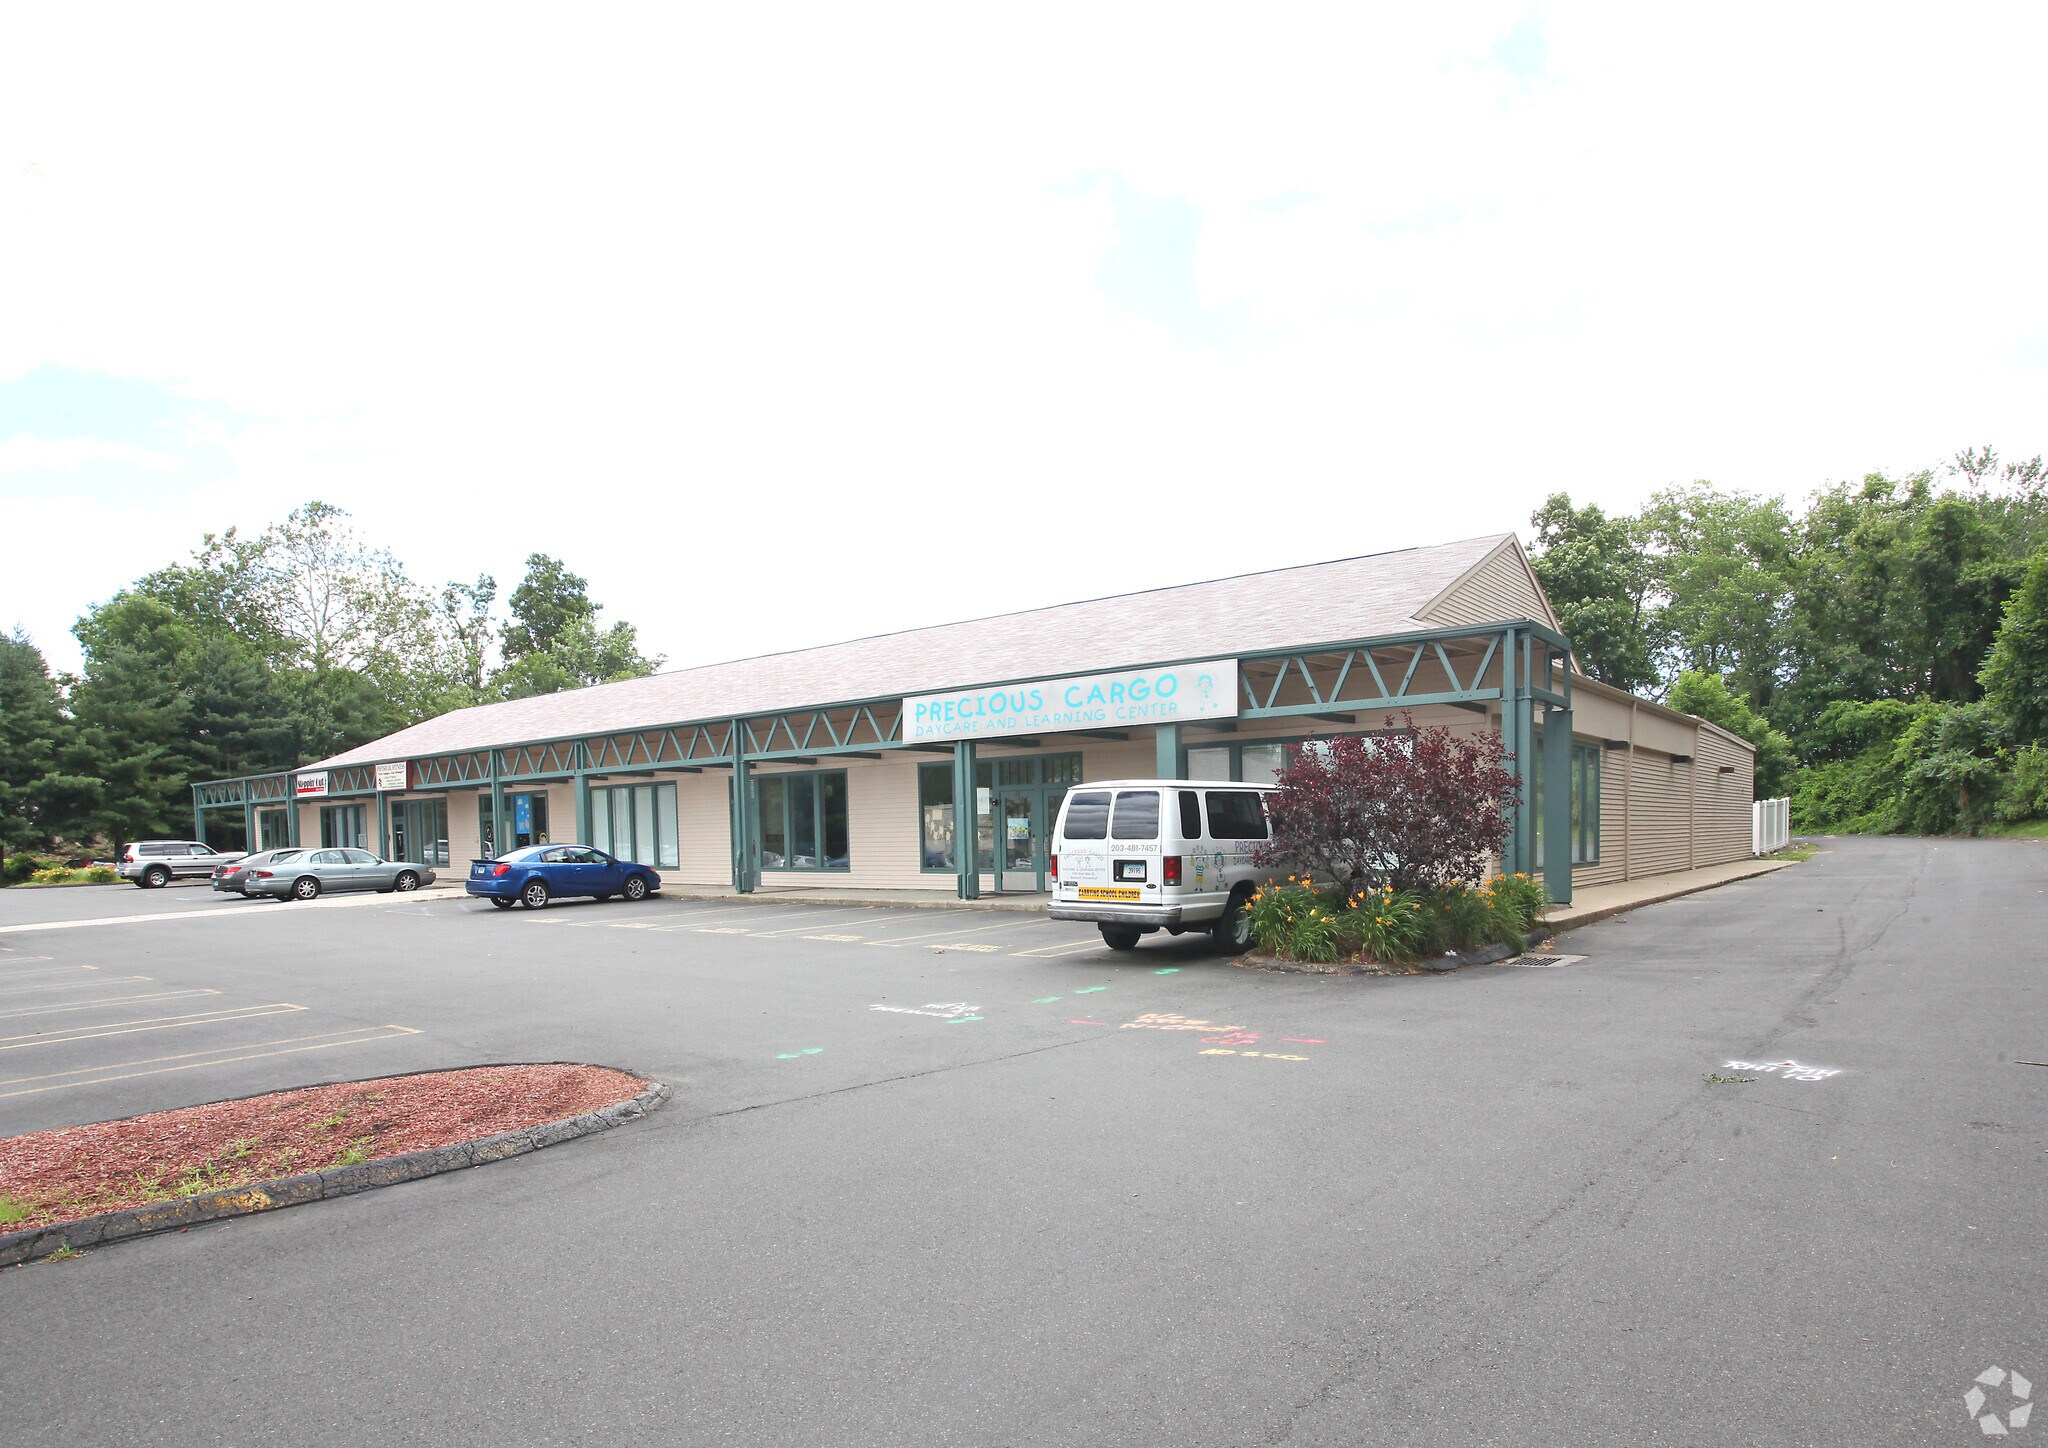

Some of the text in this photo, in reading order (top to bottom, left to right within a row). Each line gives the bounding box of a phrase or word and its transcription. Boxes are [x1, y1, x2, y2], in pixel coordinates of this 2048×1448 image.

[915, 674, 1178, 722] PRECIOUS CARGO
[915, 702, 1178, 737] DAYCARE AND LEARNING CENTER
[1111, 844, 1157, 852] 203-481-7457
[1235, 841, 1267, 853] PRECIO
[1100, 889, 1117, 897] SCHOOL
